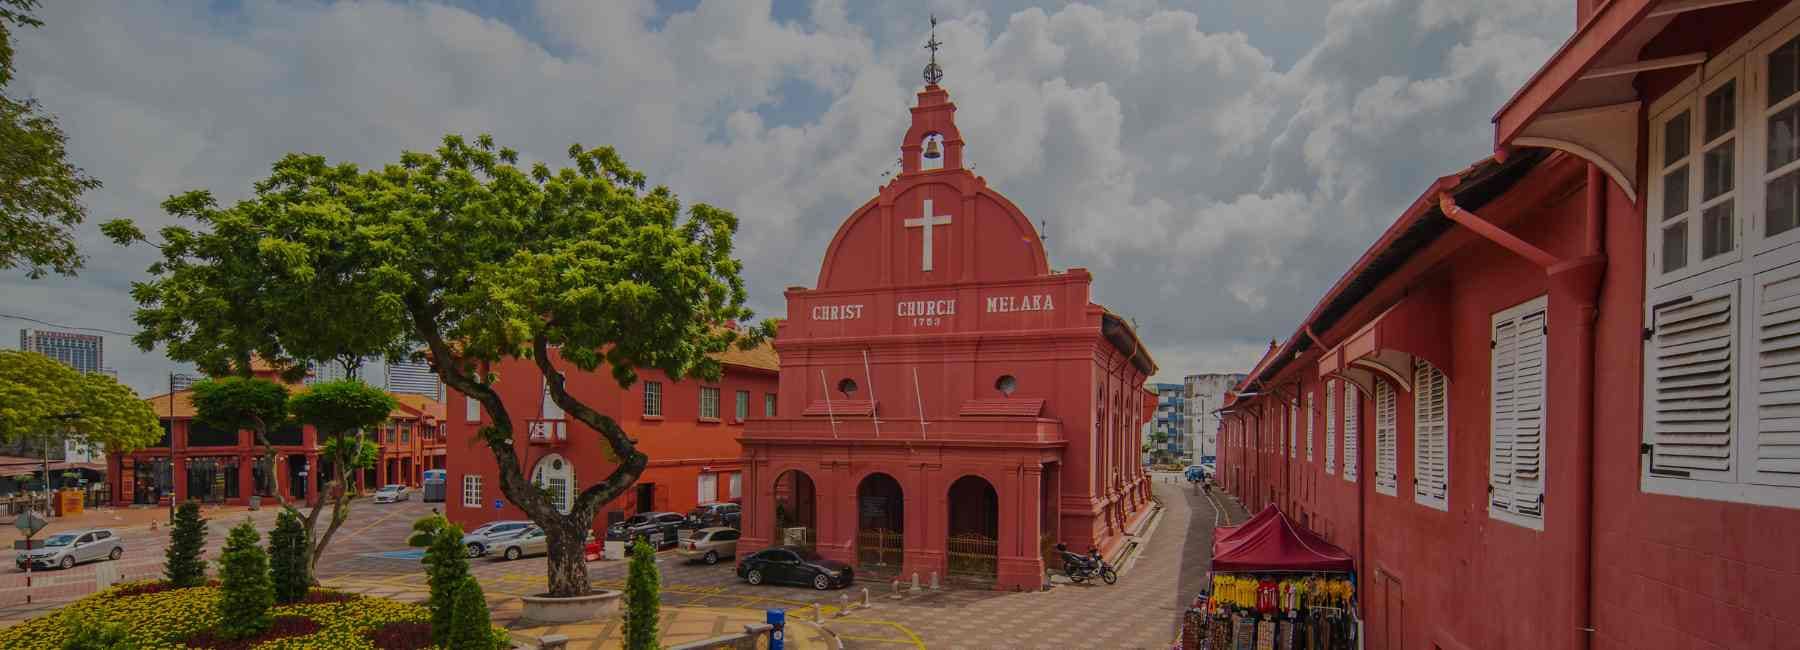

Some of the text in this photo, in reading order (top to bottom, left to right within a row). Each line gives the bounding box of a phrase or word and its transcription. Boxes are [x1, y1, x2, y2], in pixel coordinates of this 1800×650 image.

[812, 295, 1054, 321] CHRIST CHURCH MELAKA
